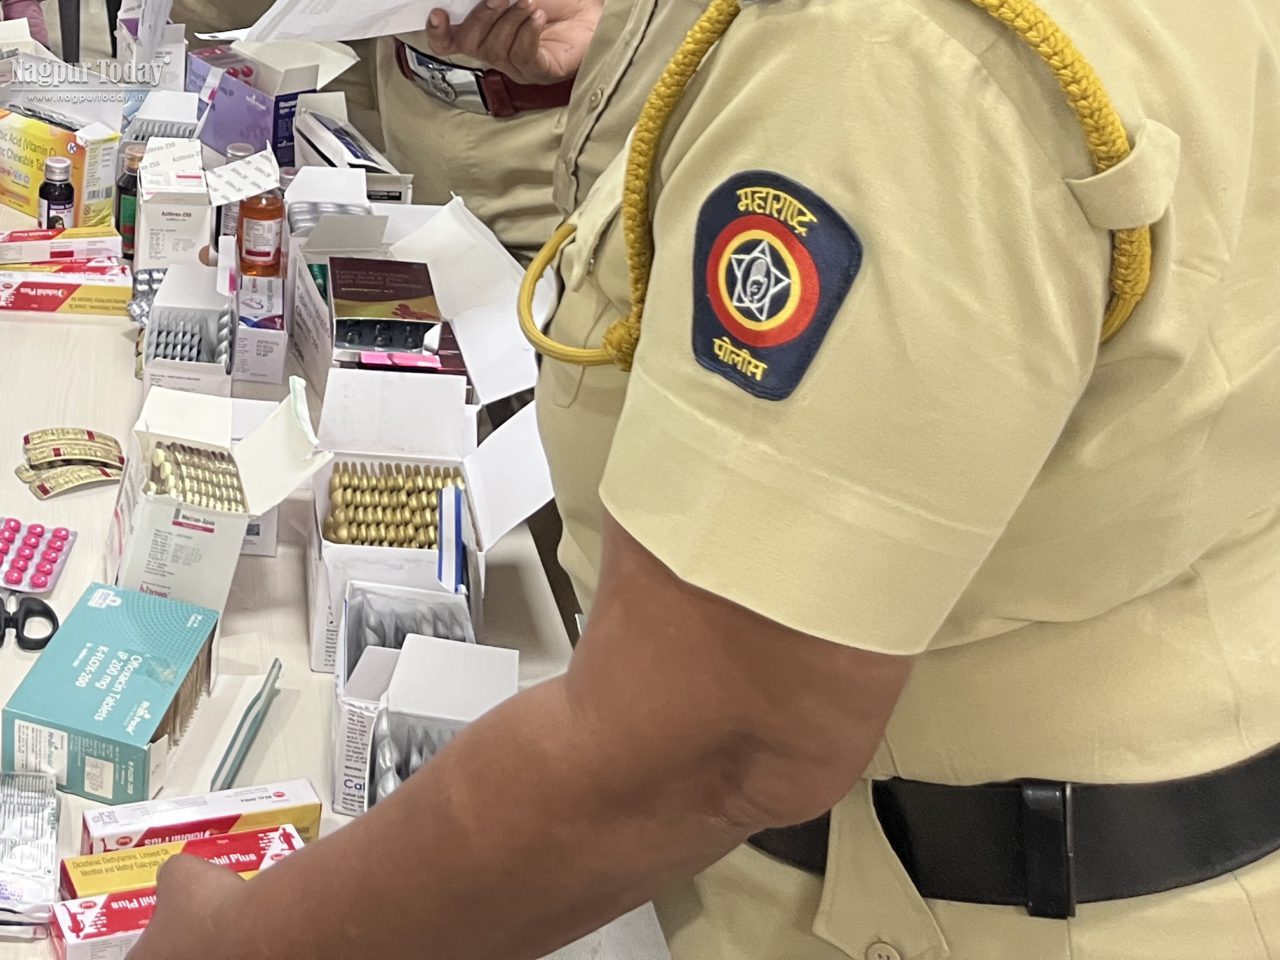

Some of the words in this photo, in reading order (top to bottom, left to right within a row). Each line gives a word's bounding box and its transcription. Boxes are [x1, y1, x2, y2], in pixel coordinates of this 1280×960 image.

[9, 132, 22, 148] Acid
[22, 139, 48, 156] (Vitamin
[6, 148, 34, 169] Chewable
[736, 187, 818, 237] महाराष्ट्र
[712, 336, 768, 381] पोलीस
[117, 650, 129, 660] IP
[75, 645, 110, 688] K-FLOX-200
[106, 659, 124, 676] 200
[111, 655, 143, 692] Ofloxacin
[94, 674, 112, 690] mg
[94, 692, 121, 721] Tablets
[230, 852, 257, 866] Plus
[110, 899, 139, 911] Plus
